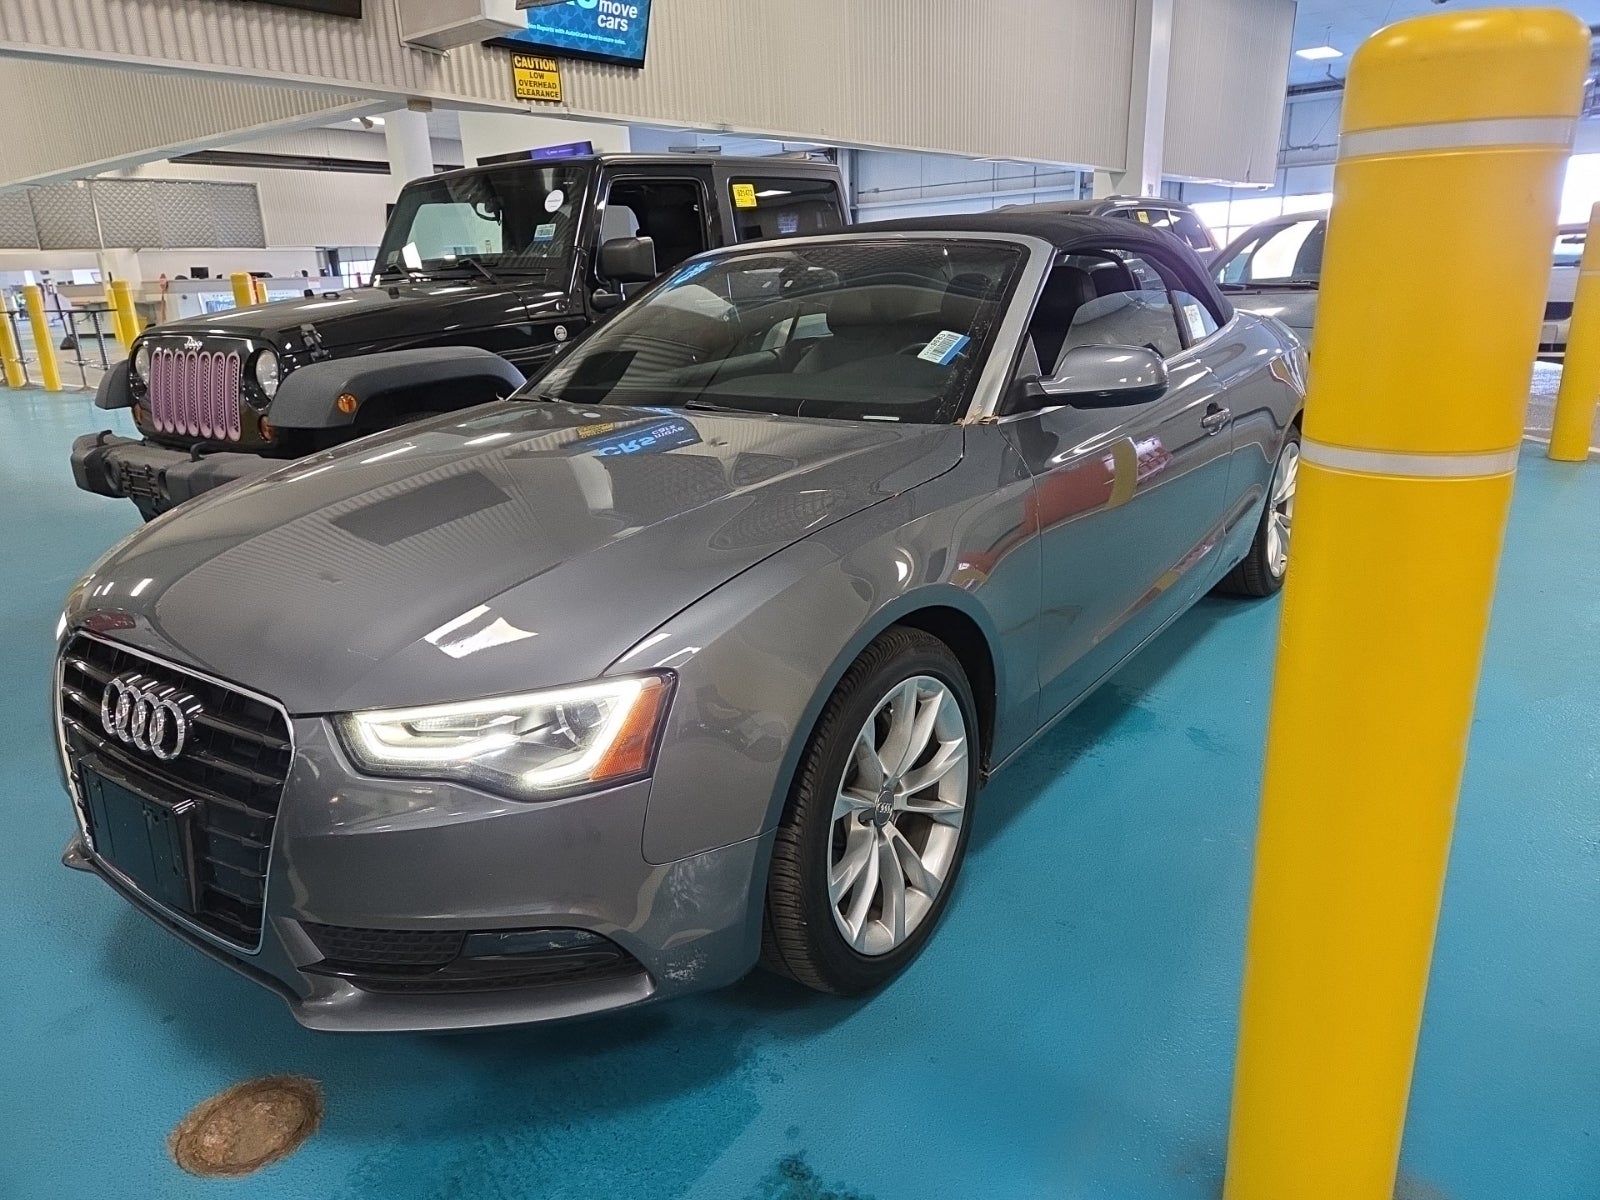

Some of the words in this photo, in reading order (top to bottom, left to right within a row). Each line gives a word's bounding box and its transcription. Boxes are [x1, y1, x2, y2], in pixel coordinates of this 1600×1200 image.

[599, 0, 638, 18] move
[597, 15, 628, 31] cars
[514, 55, 557, 71] CAUTION
[529, 71, 545, 80] LOW
[518, 79, 557, 89] OVERHEAD
[517, 88, 559, 98] CLEARANCE
